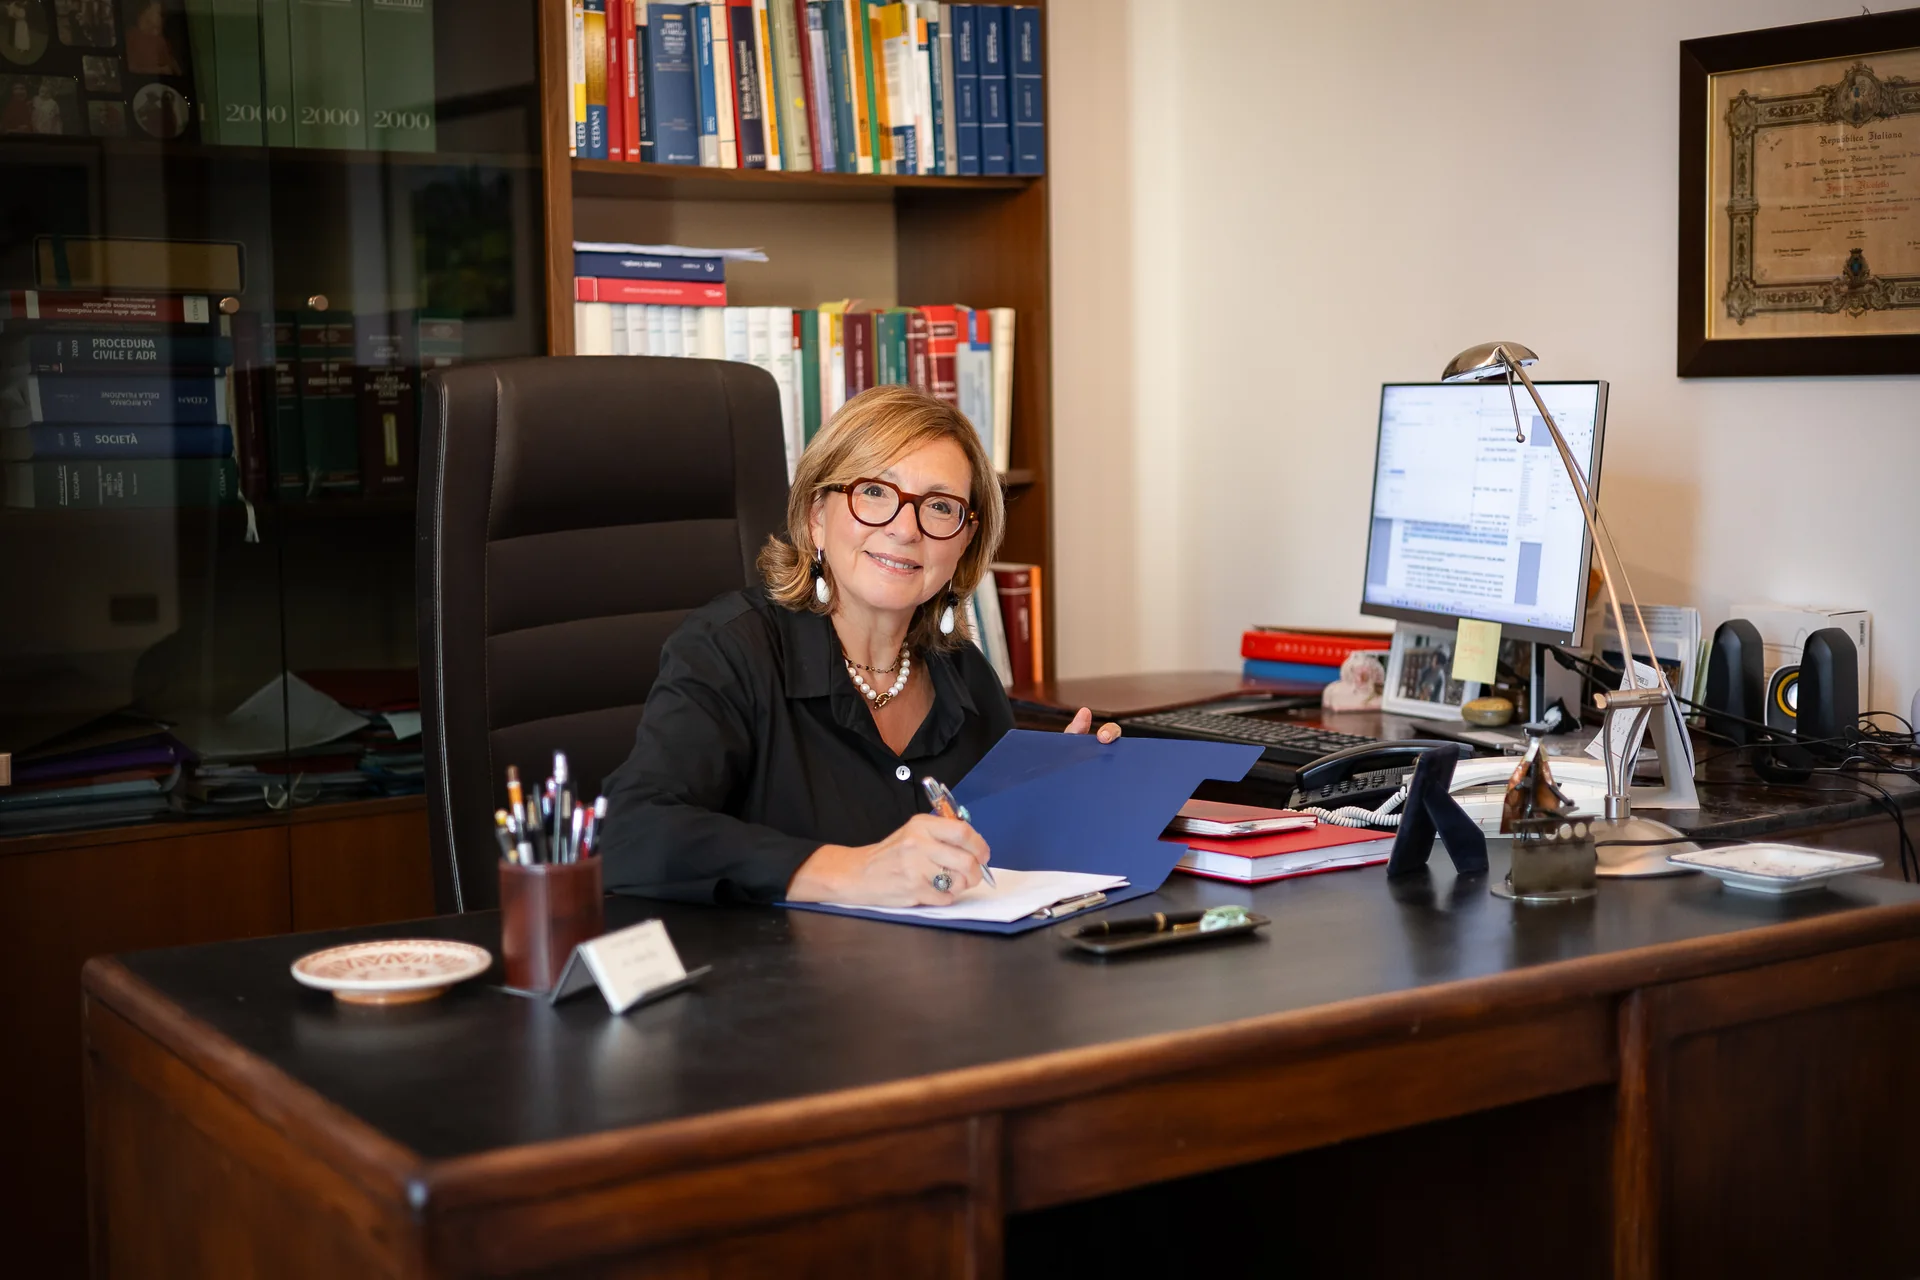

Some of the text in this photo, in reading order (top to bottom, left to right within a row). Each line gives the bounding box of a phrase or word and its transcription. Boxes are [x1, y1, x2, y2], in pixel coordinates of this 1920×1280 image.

[226, 104, 286, 124] 2000
[301, 106, 360, 127] 2000
[373, 110, 430, 130] 2000
[577, 121, 586, 148] CED
[591, 110, 601, 148] CEDAM
[1868, 131, 1903, 143] Italiana
[92, 338, 155, 349] PROCEDURA
[92, 350, 157, 360] CIVILE E ADR
[109, 399, 141, 407] RIFORMA
[178, 396, 208, 404] CEDAM
[95, 432, 138, 444] SOCIETÀ
